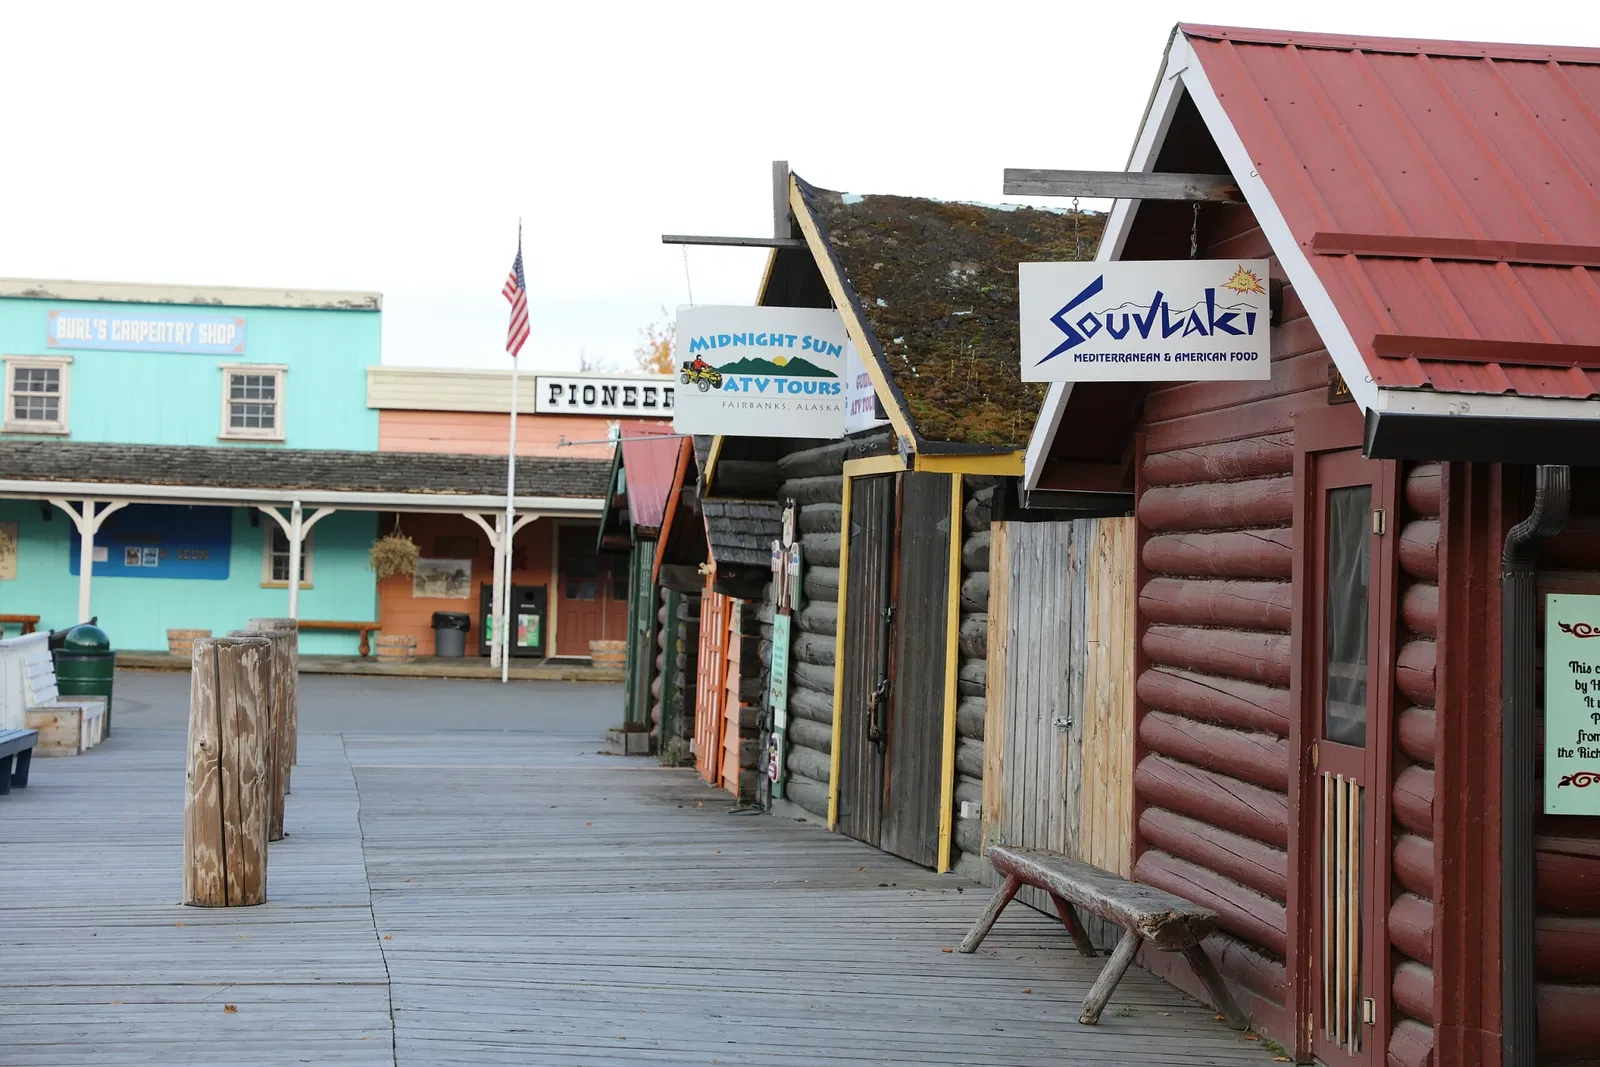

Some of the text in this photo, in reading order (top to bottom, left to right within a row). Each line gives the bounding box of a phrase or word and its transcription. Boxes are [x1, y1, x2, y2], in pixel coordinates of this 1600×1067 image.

[1033, 274, 1257, 367] SOUVLAKI
[56, 316, 236, 345] BURL'S CARPENTRY SHOP
[689, 332, 843, 358] MIDNIGHT SUN
[1073, 352, 1258, 363] MEDITERRANEAN & AMERICAN FOOD
[722, 376, 841, 395] ATV TOURS
[796, 403, 841, 412] ALASKA
[1568, 660, 1592, 674] This
[1575, 679, 1588, 694] by
[1584, 696, 1594, 708] It
[1557, 747, 1574, 758] the
